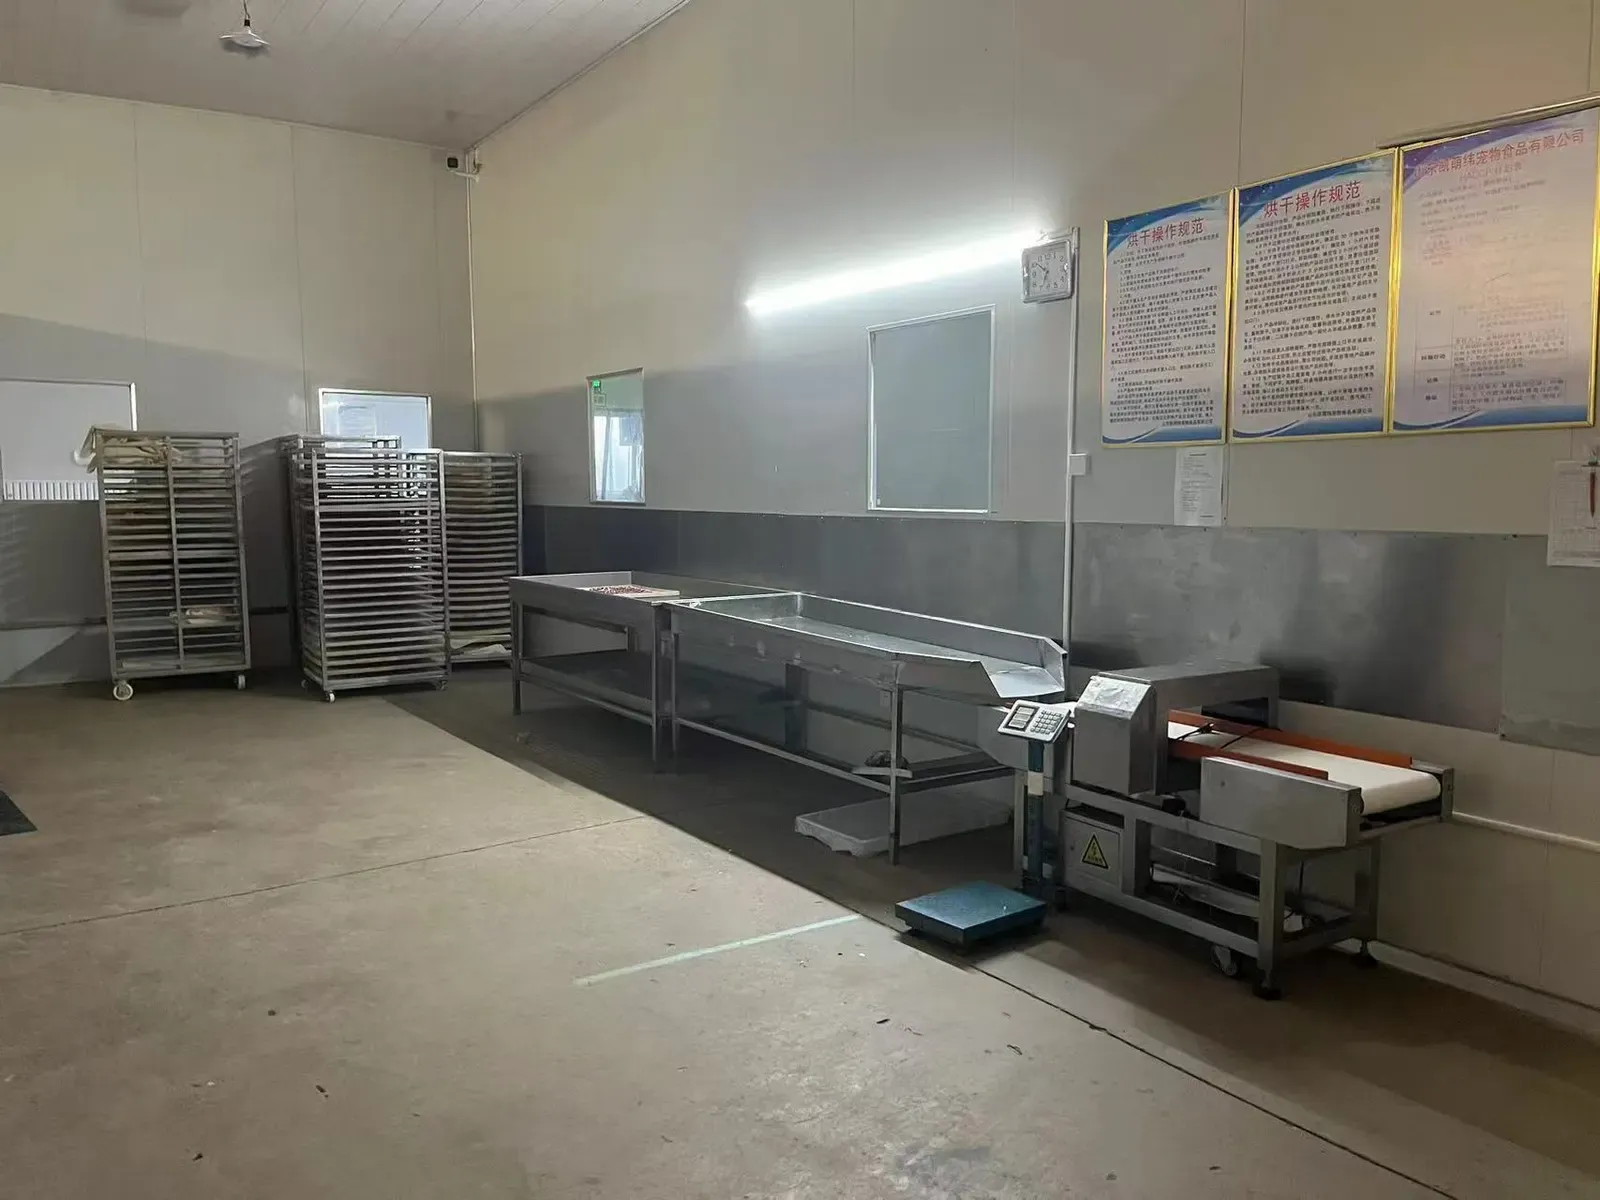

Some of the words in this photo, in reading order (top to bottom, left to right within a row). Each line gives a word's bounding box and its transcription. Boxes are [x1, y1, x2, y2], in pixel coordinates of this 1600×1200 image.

[1263, 180, 1361, 219] 烘干操作规范
[1126, 217, 1205, 249] 烘干操作规范
